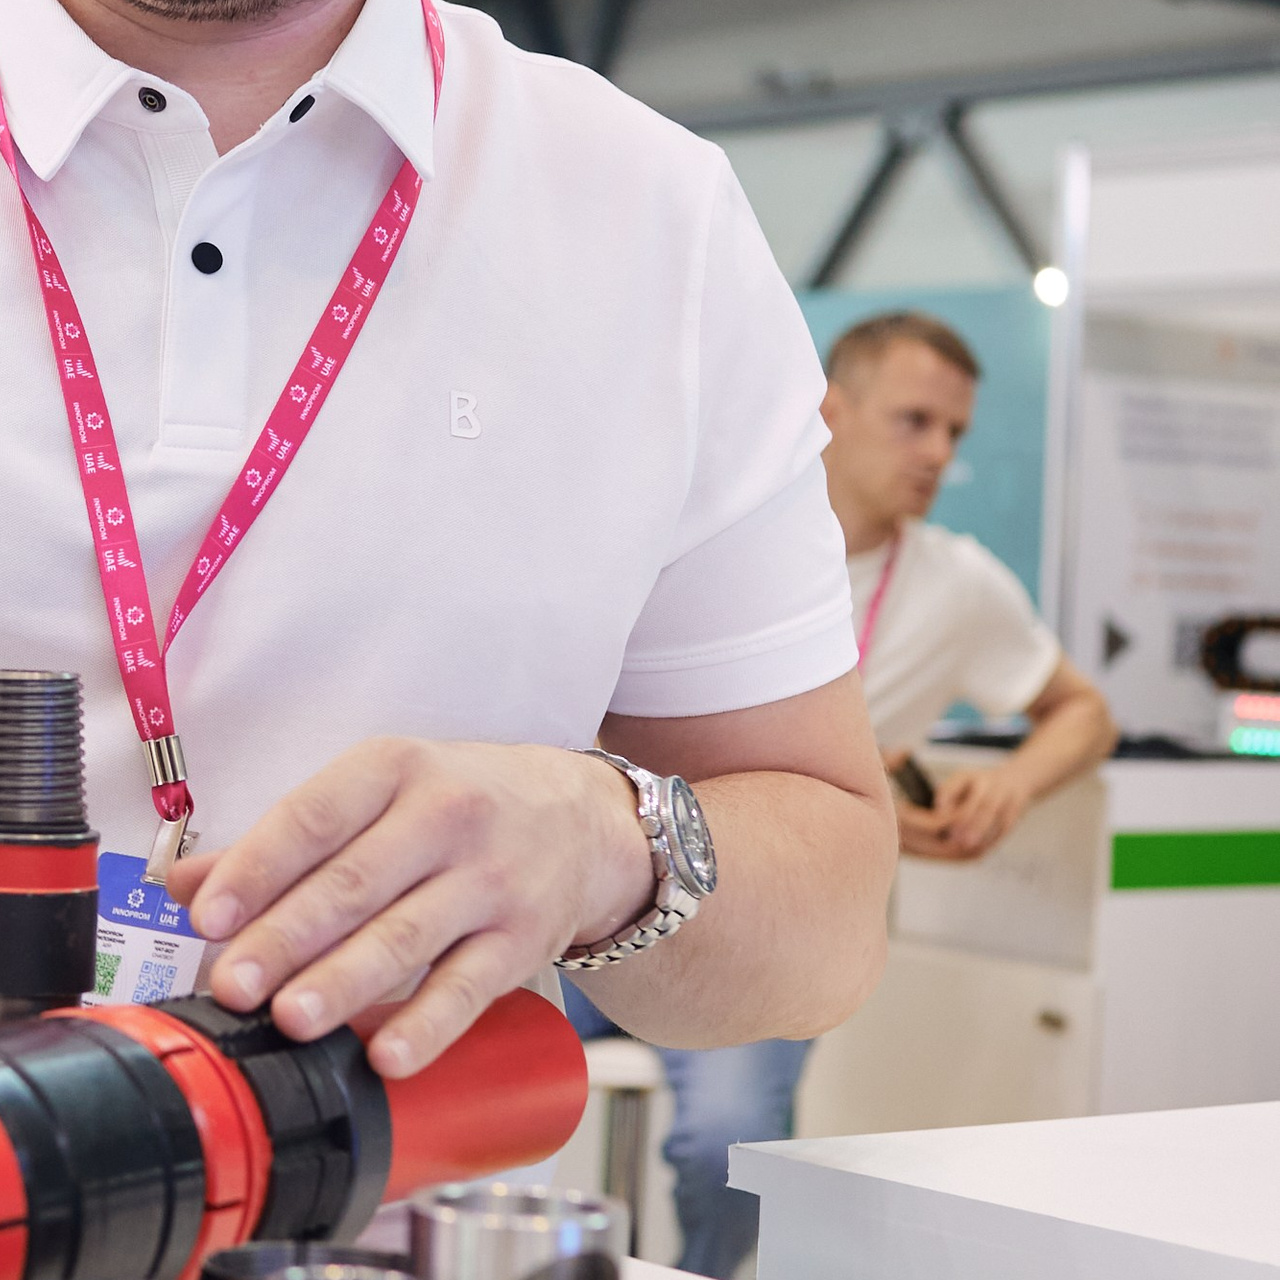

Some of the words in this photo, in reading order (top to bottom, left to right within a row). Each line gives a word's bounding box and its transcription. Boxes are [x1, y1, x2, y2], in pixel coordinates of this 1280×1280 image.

[381, 228, 399, 262] INNOPROM
[399, 203, 410, 222] UAE
[43, 270, 54, 289] UAE
[342, 303, 363, 340] INNOPROM
[361, 278, 376, 297] UAE
[53, 309, 67, 350] INNOPROM
[64, 359, 76, 379] UAE
[300, 383, 322, 421] INNOPROM
[320, 356, 336, 376] UAE
[449, 389, 482, 439] B
[73, 402, 87, 444] INNOPROM
[84, 453, 97, 474] UAE
[251, 467, 277, 507] INNOPROM
[276, 439, 292, 460] UAE
[93, 497, 108, 540] INNOPROM
[104, 550, 117, 572] UAE
[197, 553, 223, 593] INNOPROM
[224, 525, 240, 547] UAE
[113, 596, 128, 641] INNOPROM
[124, 650, 137, 673] UAE
[111, 906, 151, 921] INNOPROM
[159, 913, 180, 926] UAE
[153, 939, 180, 948] INNOPROM
